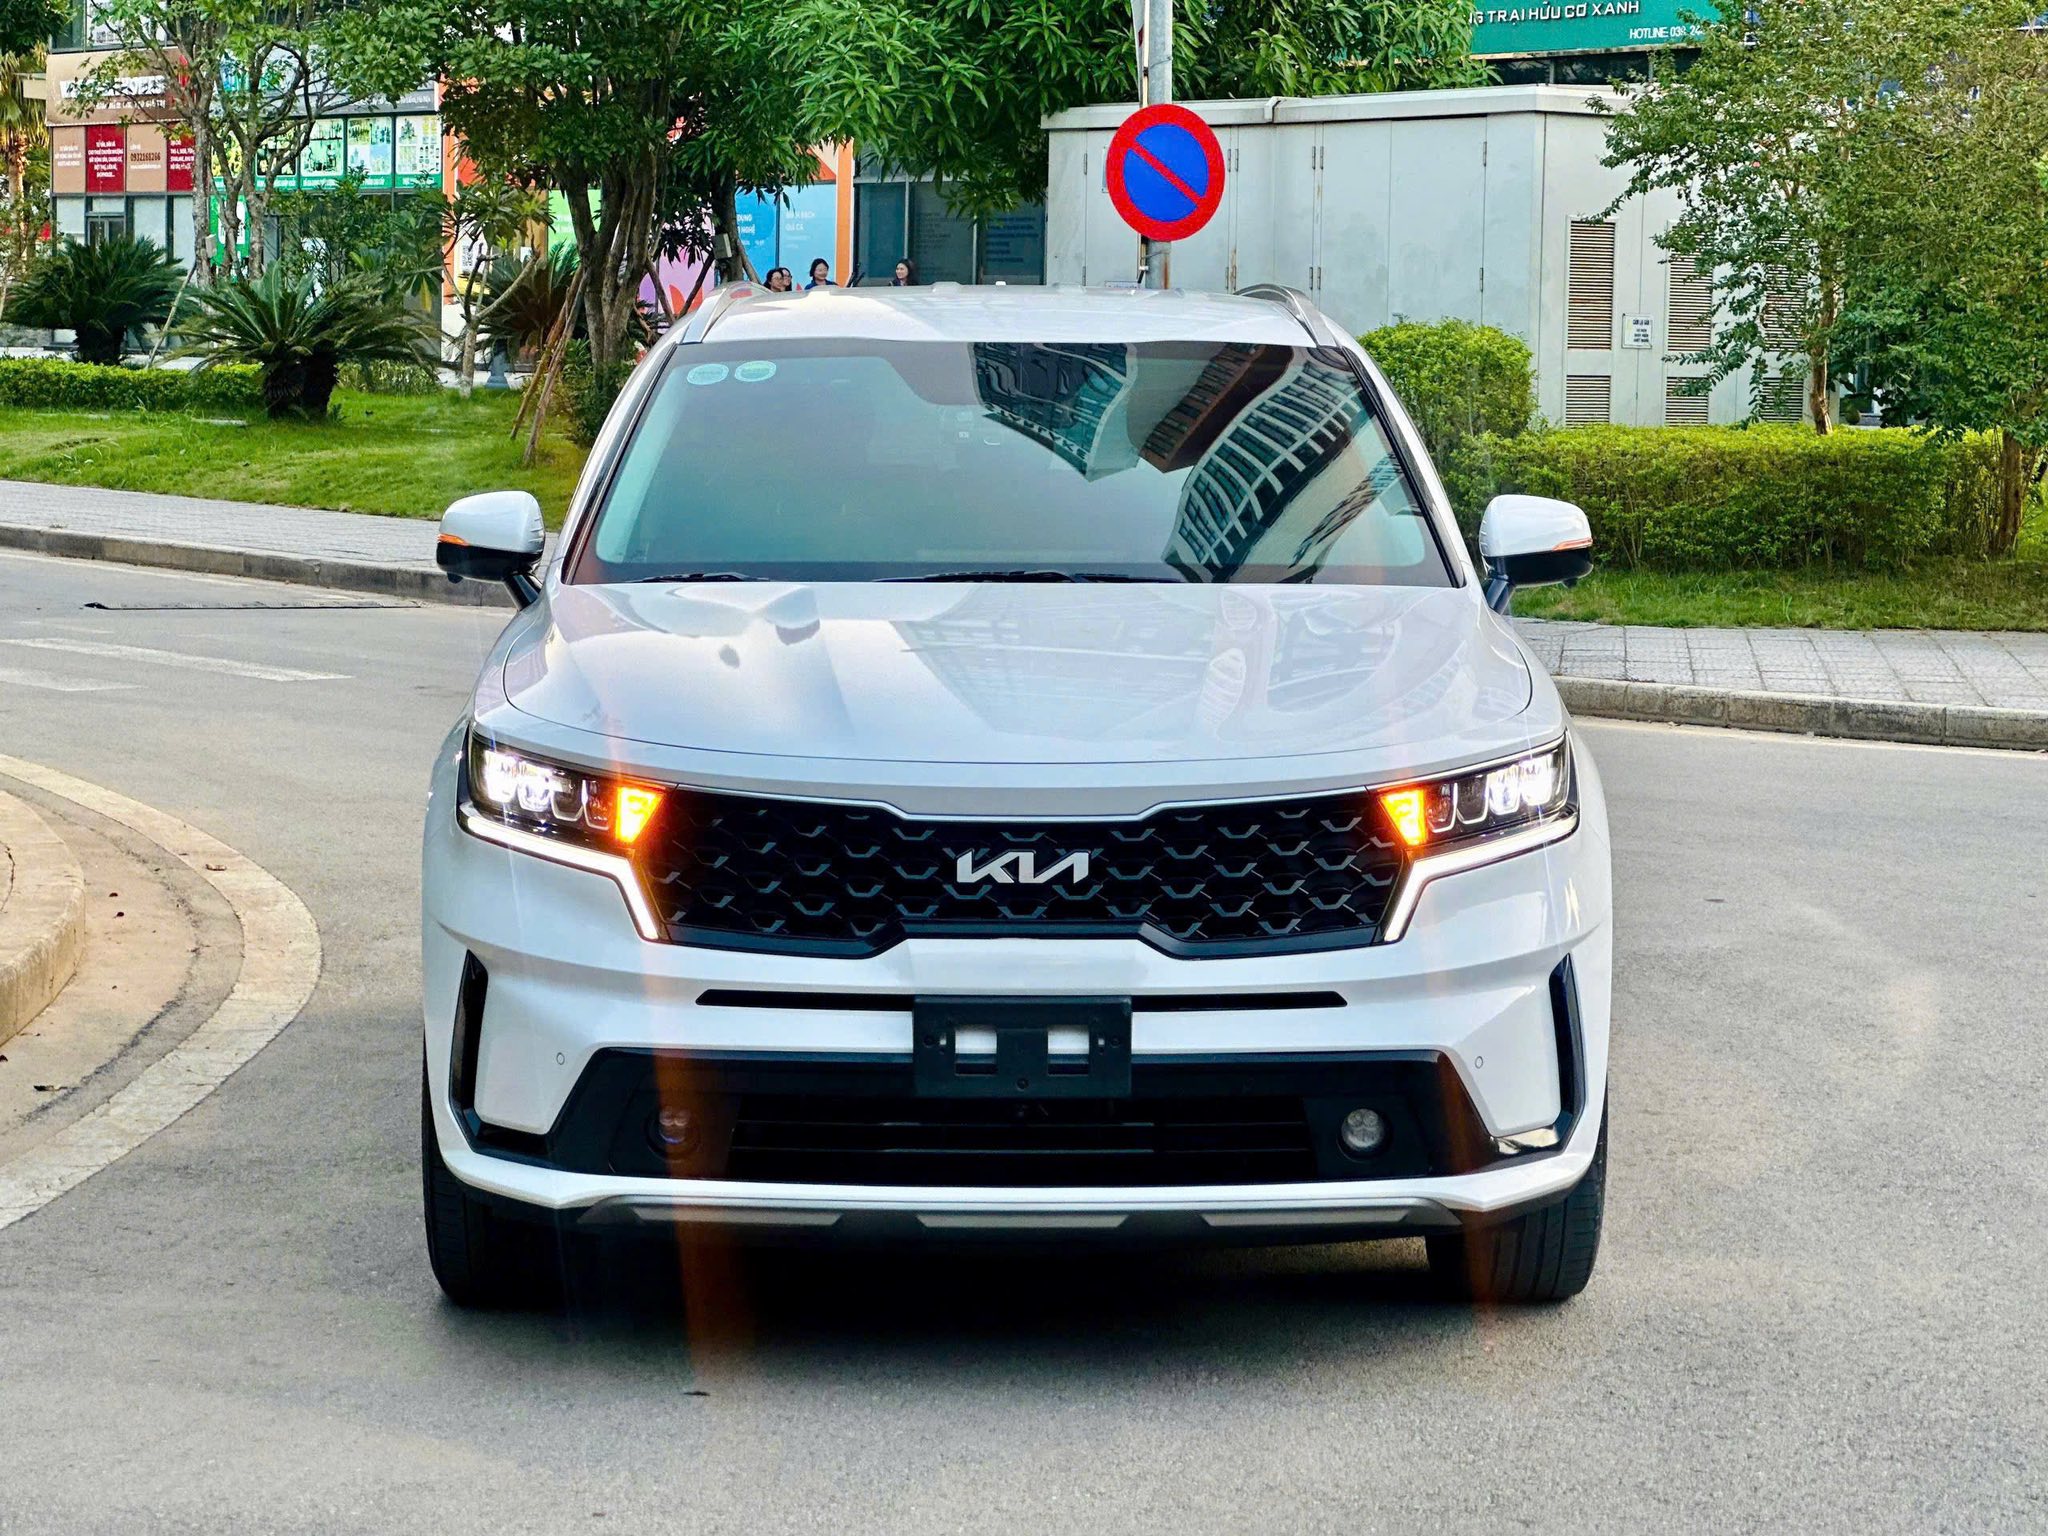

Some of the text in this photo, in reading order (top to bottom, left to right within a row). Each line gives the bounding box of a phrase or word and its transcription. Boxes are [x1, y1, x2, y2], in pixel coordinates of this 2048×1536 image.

[1487, 8, 1525, 26] TRẠI
[1528, 1, 1561, 20] HỮU
[1564, 2, 1587, 18] CƠ
[1591, 0, 1640, 16] XANH
[956, 850, 1090, 884] KIA
